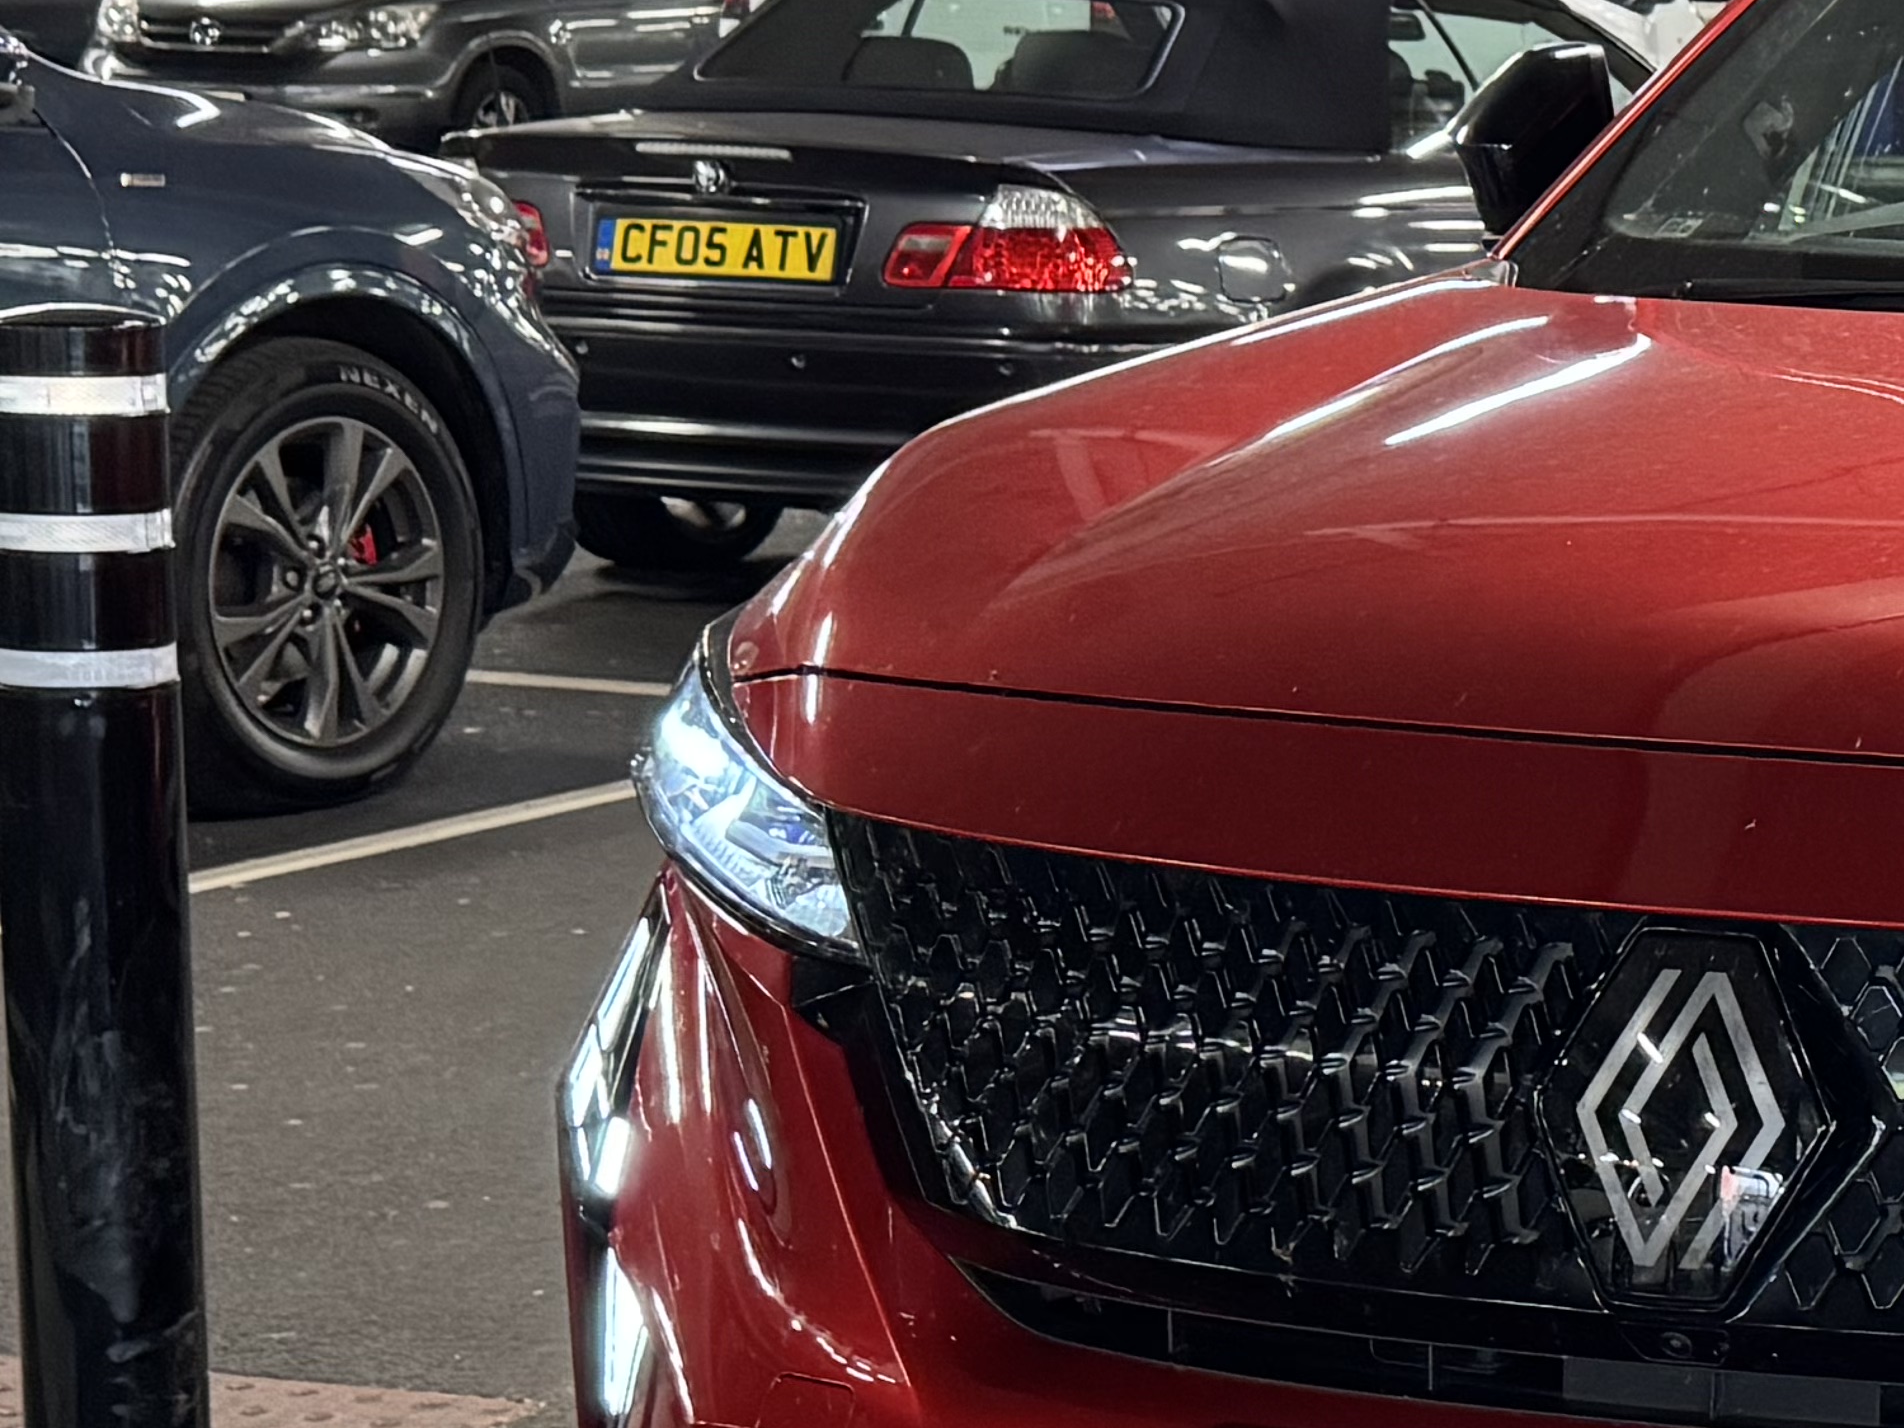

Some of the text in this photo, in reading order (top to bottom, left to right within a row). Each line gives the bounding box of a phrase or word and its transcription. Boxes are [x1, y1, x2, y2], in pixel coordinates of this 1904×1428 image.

[620, 222, 828, 274] CF05 ATV
[337, 364, 438, 434] NEXEN
